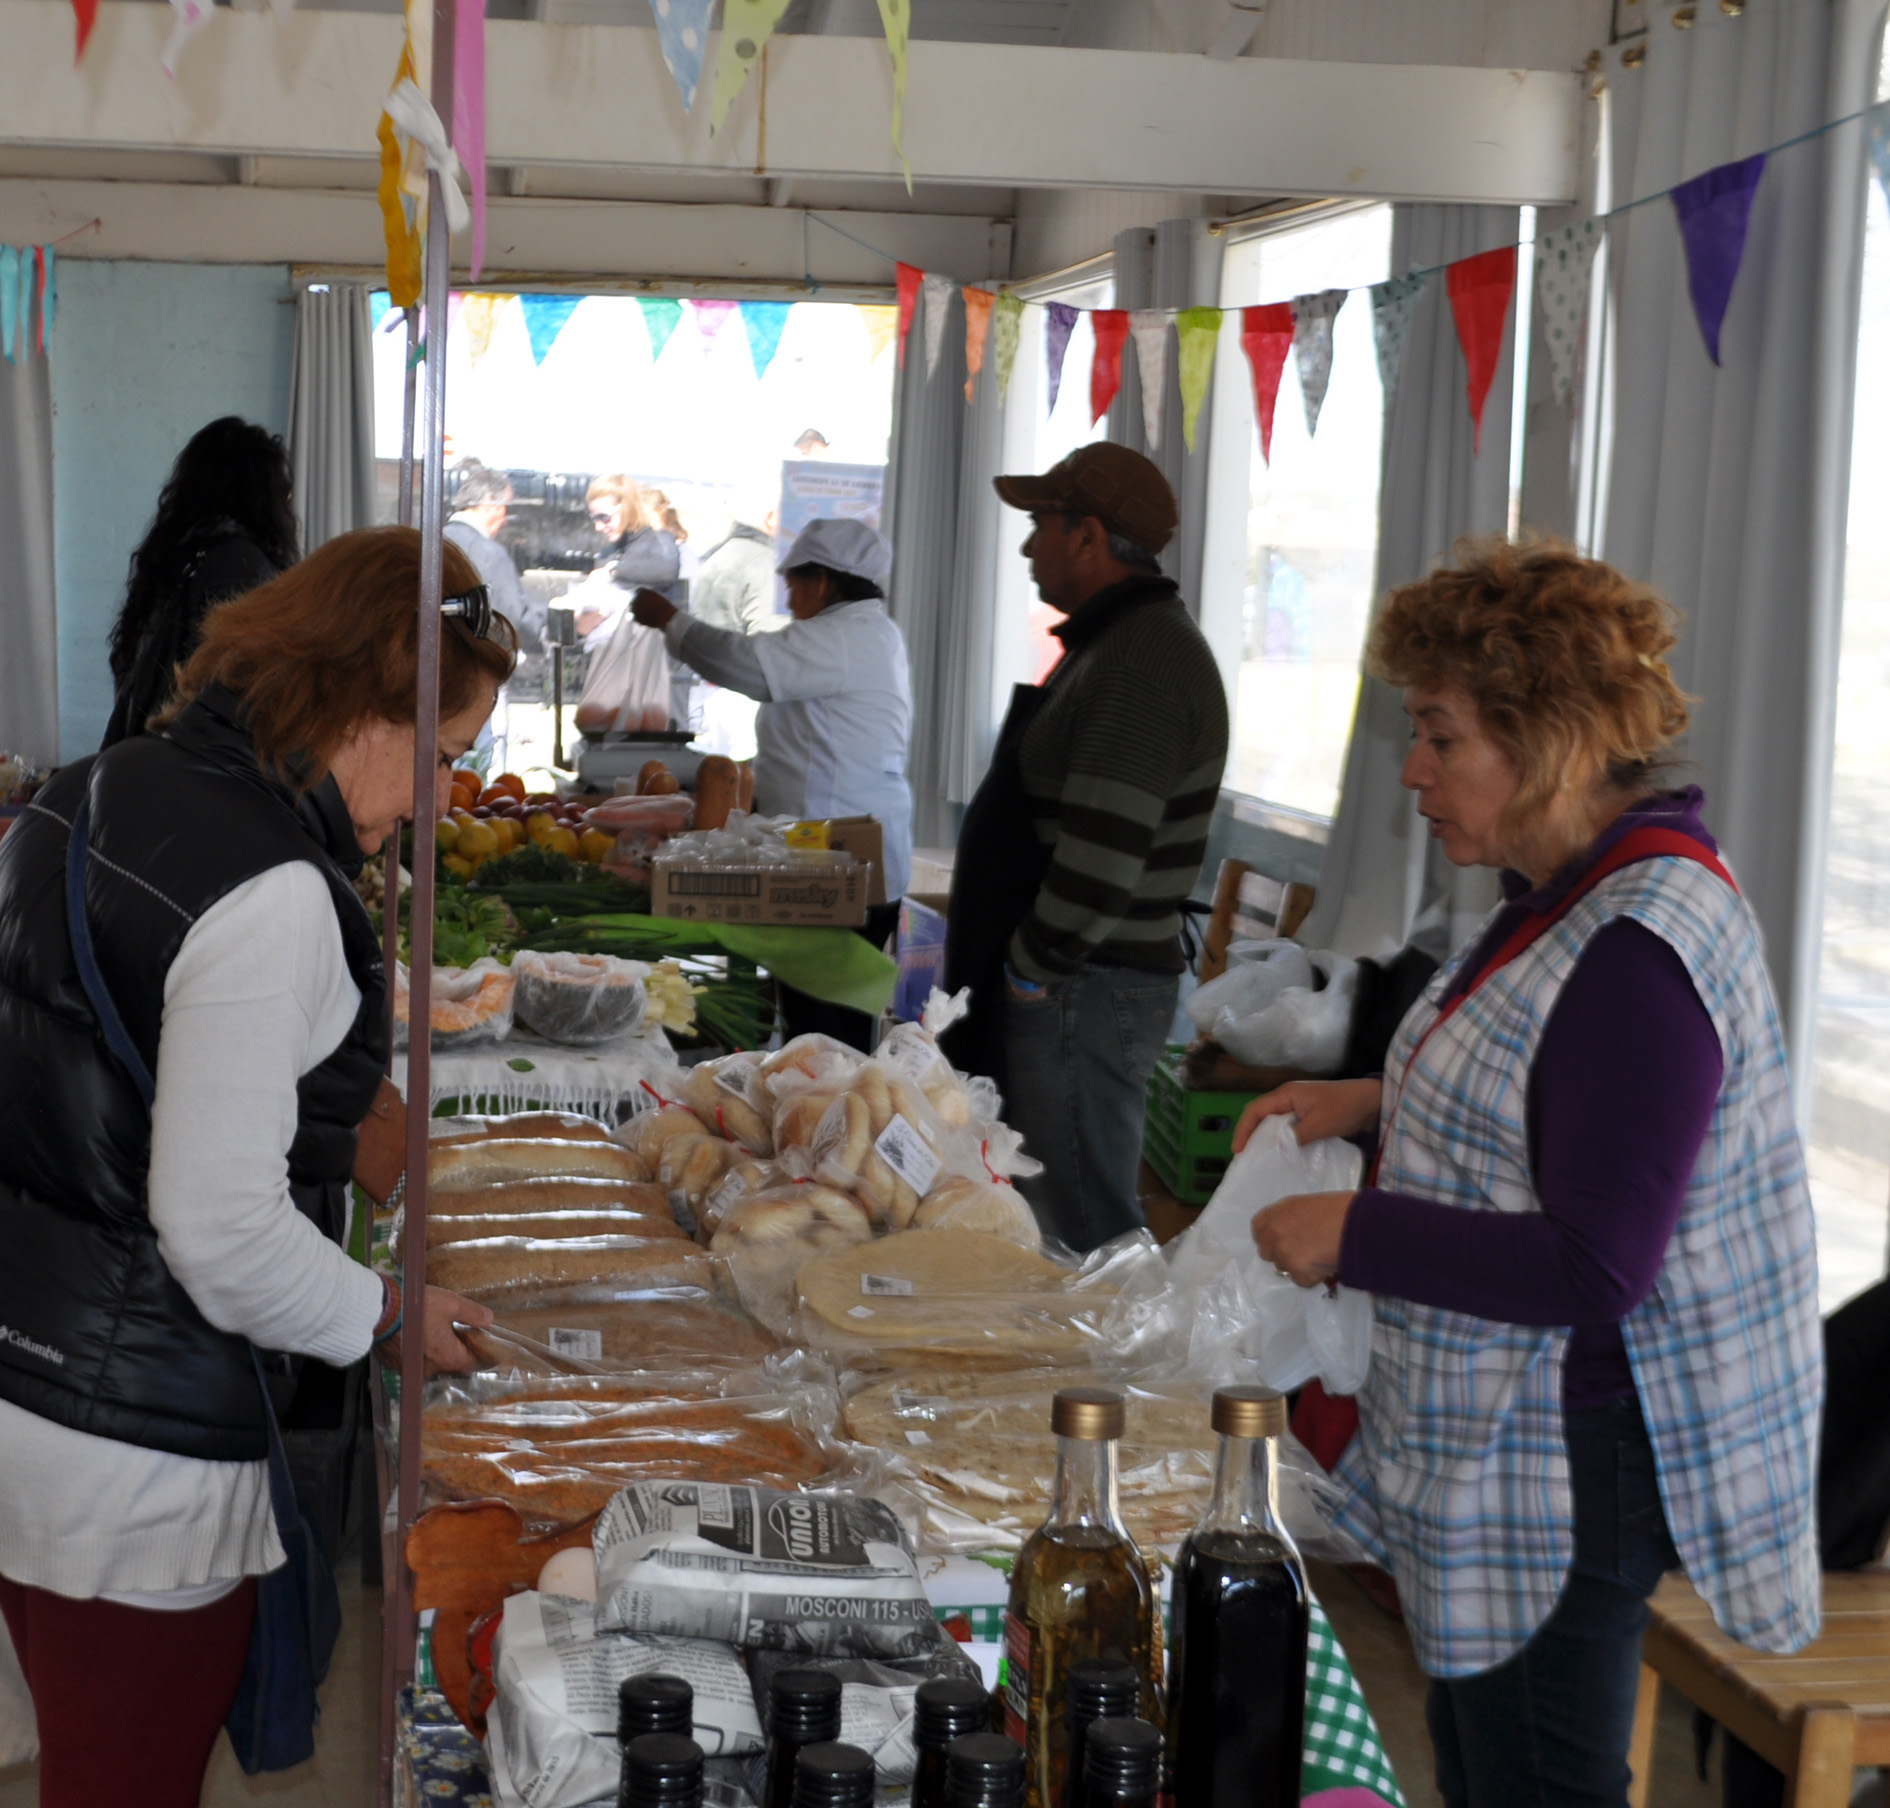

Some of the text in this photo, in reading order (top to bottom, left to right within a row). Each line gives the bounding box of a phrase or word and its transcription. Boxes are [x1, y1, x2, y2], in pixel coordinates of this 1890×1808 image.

[8, 1329, 65, 1365] Columbia
[788, 1499, 814, 1557] UNION
[785, 1596, 866, 1619] MOSCONI
[872, 1601, 899, 1620] 115
